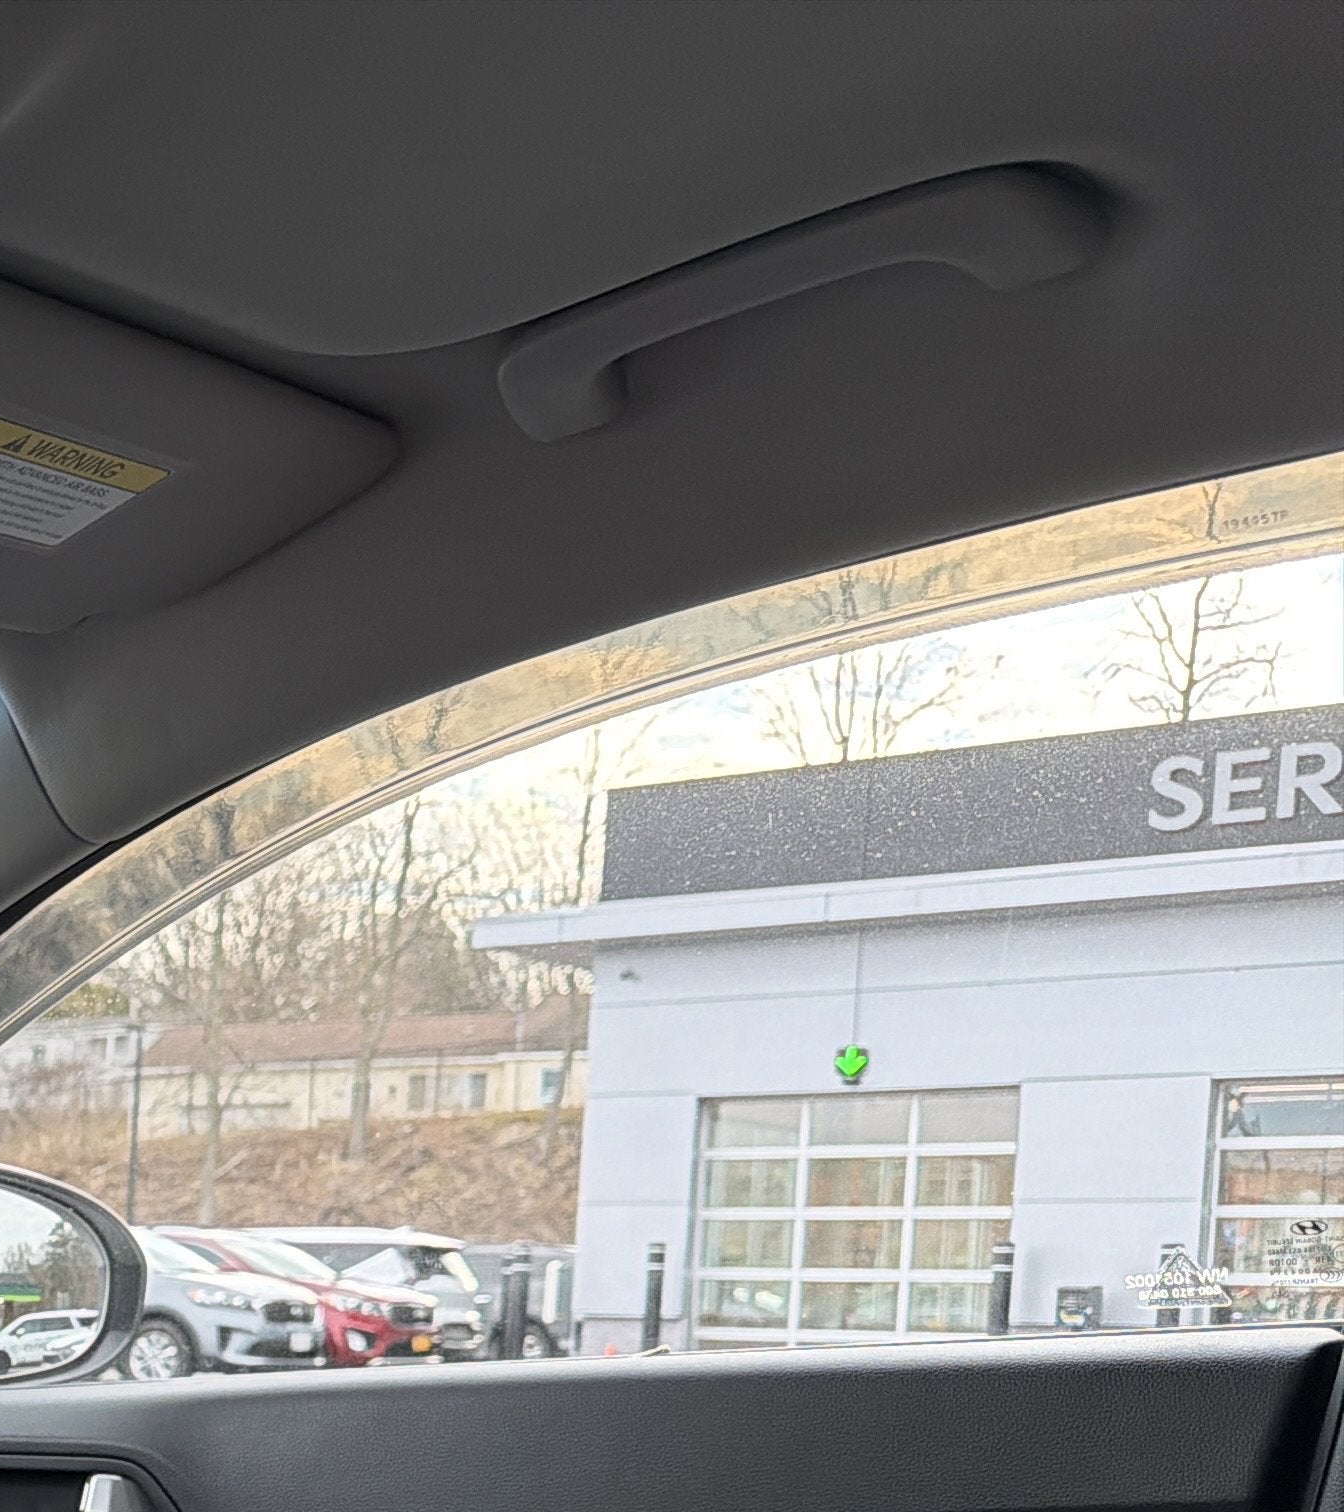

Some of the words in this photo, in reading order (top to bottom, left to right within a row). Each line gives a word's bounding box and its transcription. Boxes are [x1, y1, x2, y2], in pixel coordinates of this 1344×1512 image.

[32, 439, 126, 479] WARNING
[17, 464, 67, 485] ADVANCED
[67, 479, 83, 491] AIR
[83, 484, 110, 498] BAGS
[1148, 742, 1344, 832] SER
